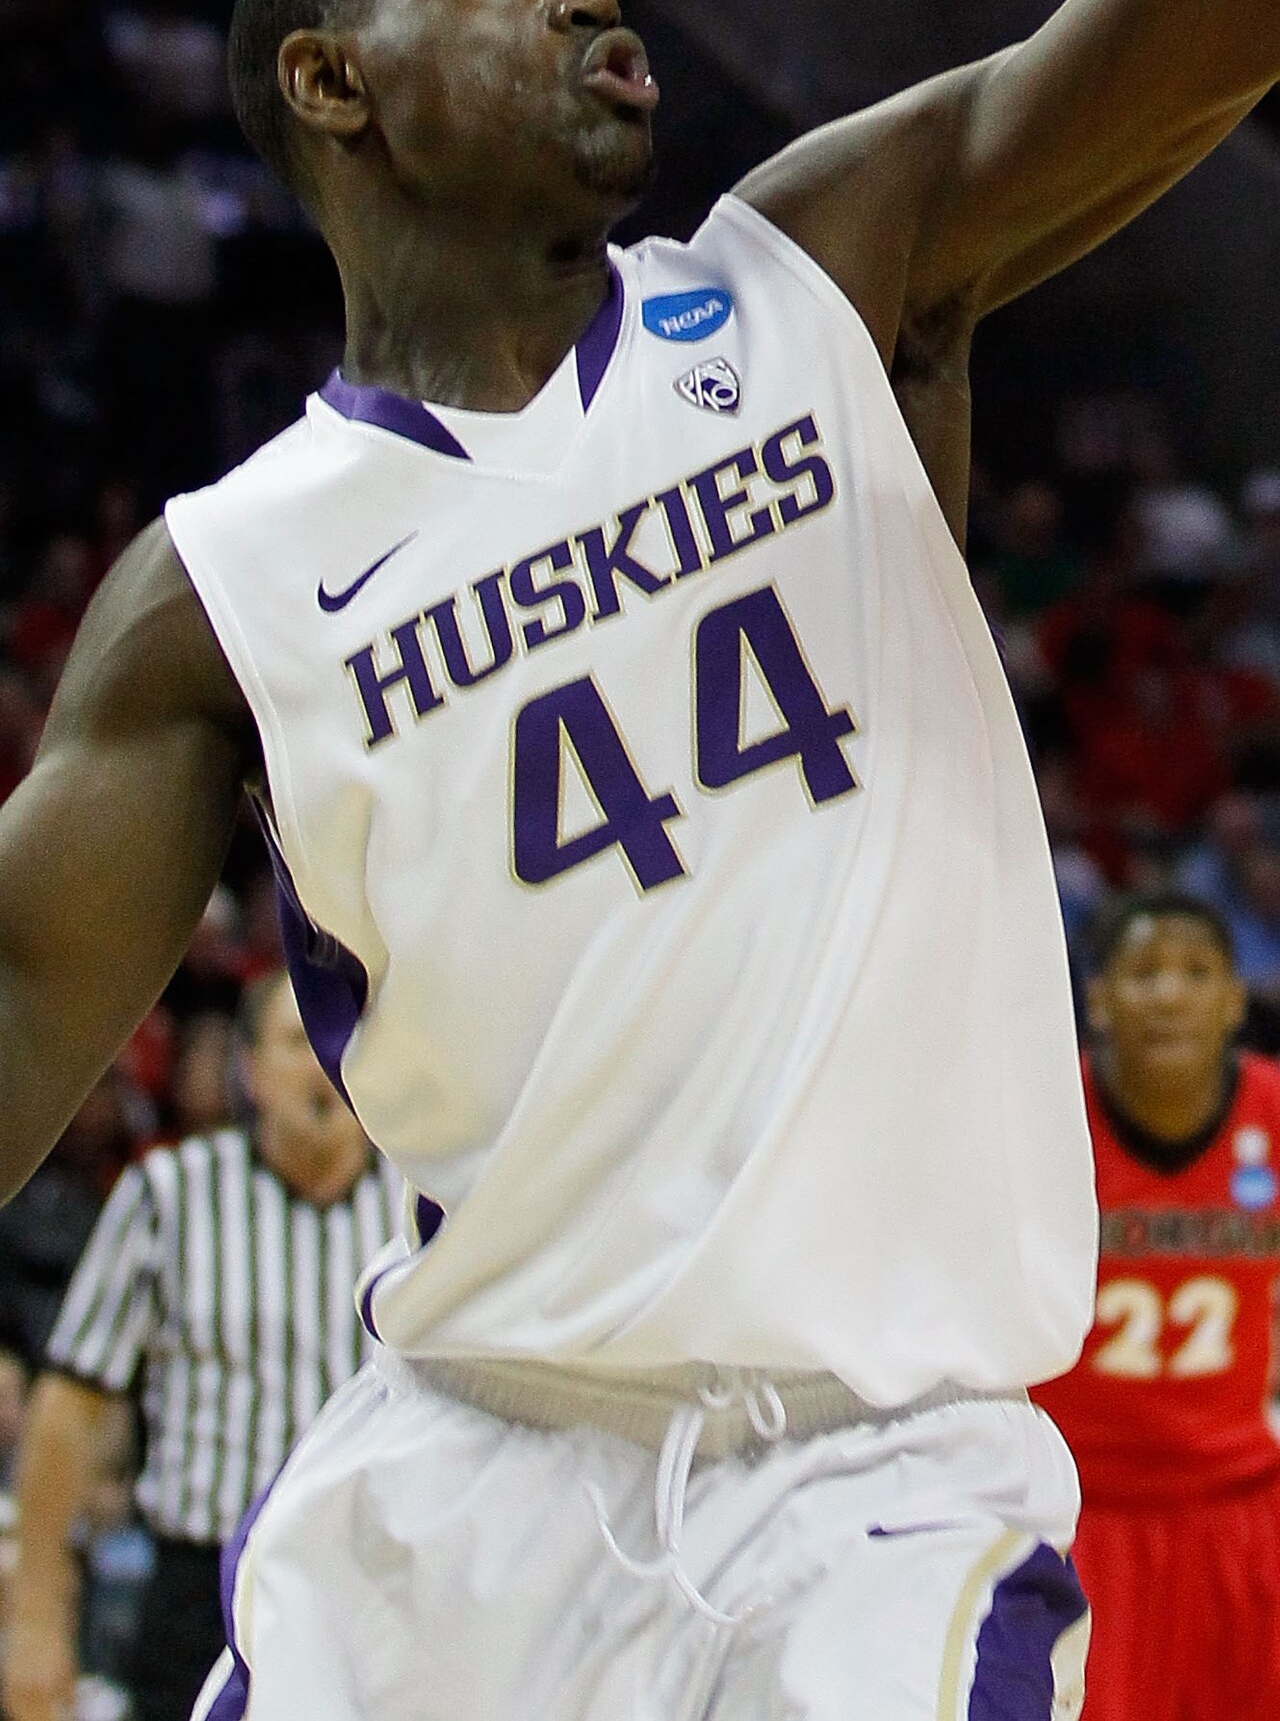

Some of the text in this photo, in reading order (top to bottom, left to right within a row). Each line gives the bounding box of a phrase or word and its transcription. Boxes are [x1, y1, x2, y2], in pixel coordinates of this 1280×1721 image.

[658, 297, 724, 336] NCAA
[343, 411, 838, 756] HUSKIES
[508, 580, 863, 897] 44
[1093, 1275, 1238, 1379] 22
